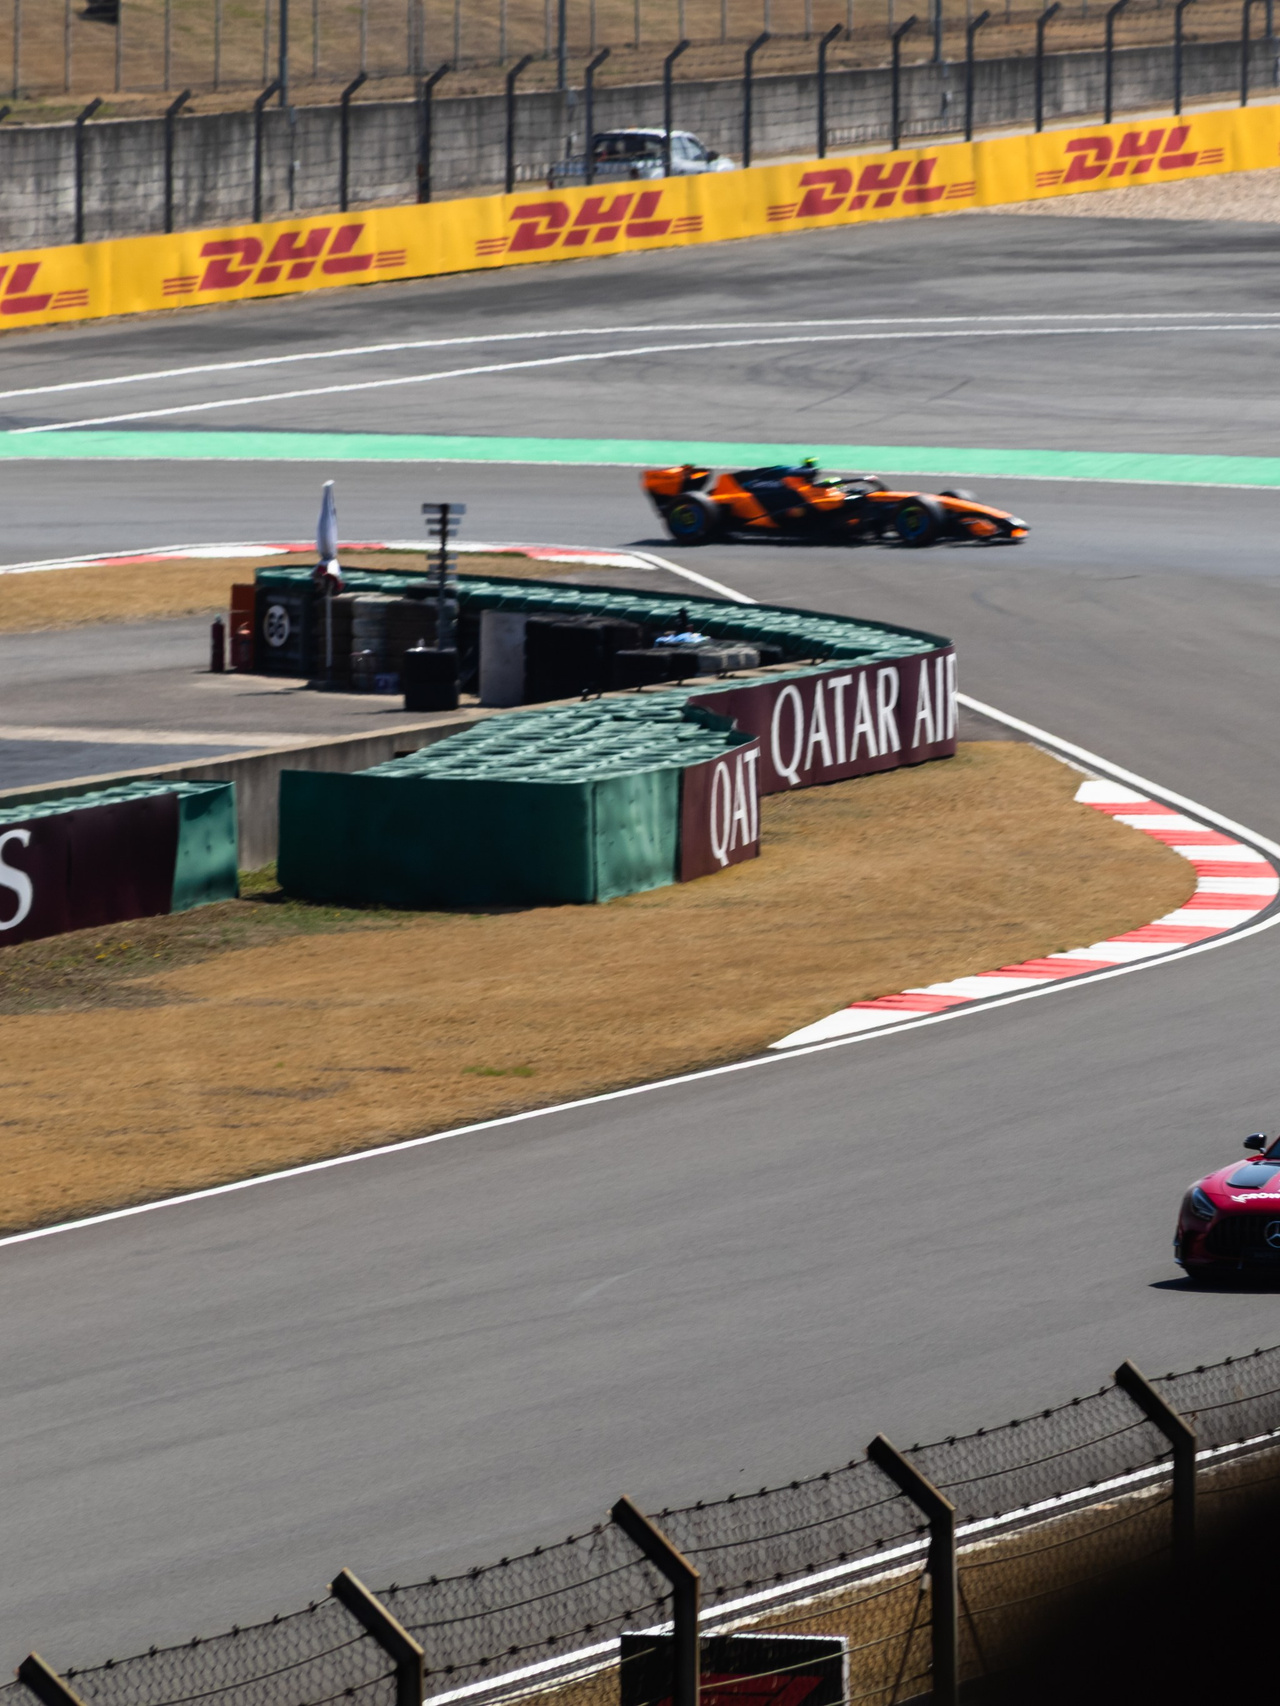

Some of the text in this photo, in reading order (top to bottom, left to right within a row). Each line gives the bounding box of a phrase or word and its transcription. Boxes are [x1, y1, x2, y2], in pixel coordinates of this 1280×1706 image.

[1063, 126, 1198, 183] DHL
[796, 158, 946, 218] DHL
[508, 191, 672, 252] DHL
[200, 223, 374, 291] DHL
[770, 666, 902, 786] QATAR
